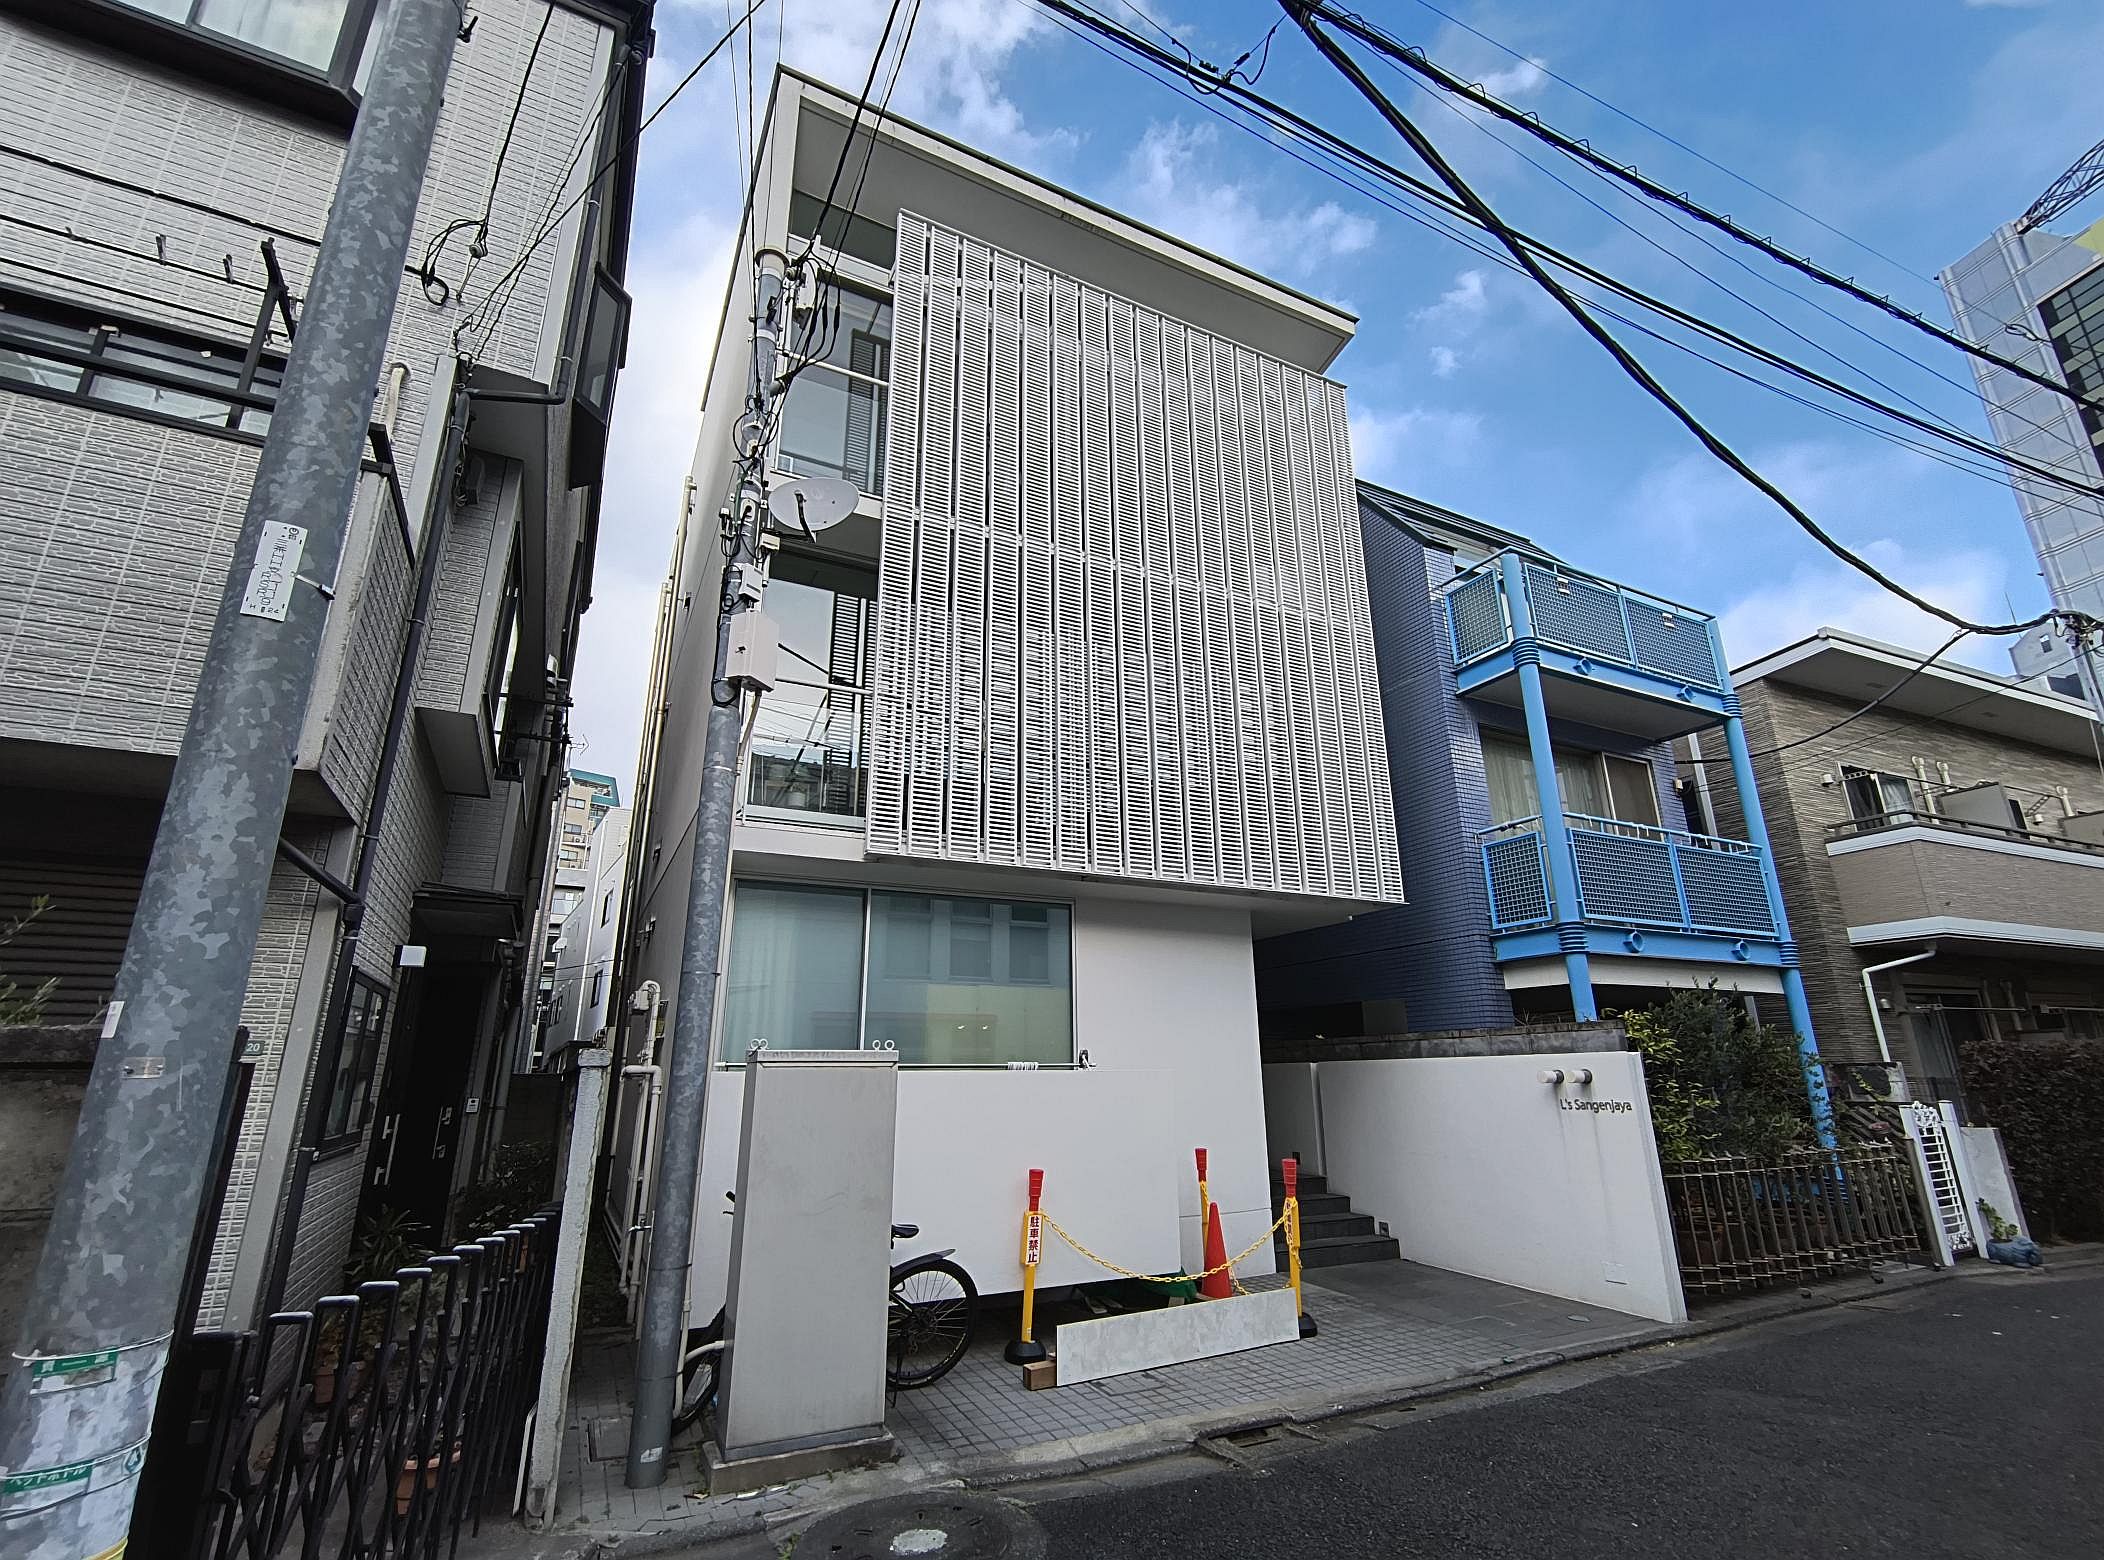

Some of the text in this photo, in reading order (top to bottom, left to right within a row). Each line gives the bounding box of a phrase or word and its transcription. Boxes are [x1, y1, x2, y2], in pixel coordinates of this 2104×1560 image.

[246, 1043, 260, 1052] 20
[1560, 1098, 1632, 1113] L's Sangenjaya
[1028, 1216, 1040, 1263] 駐車禁止
